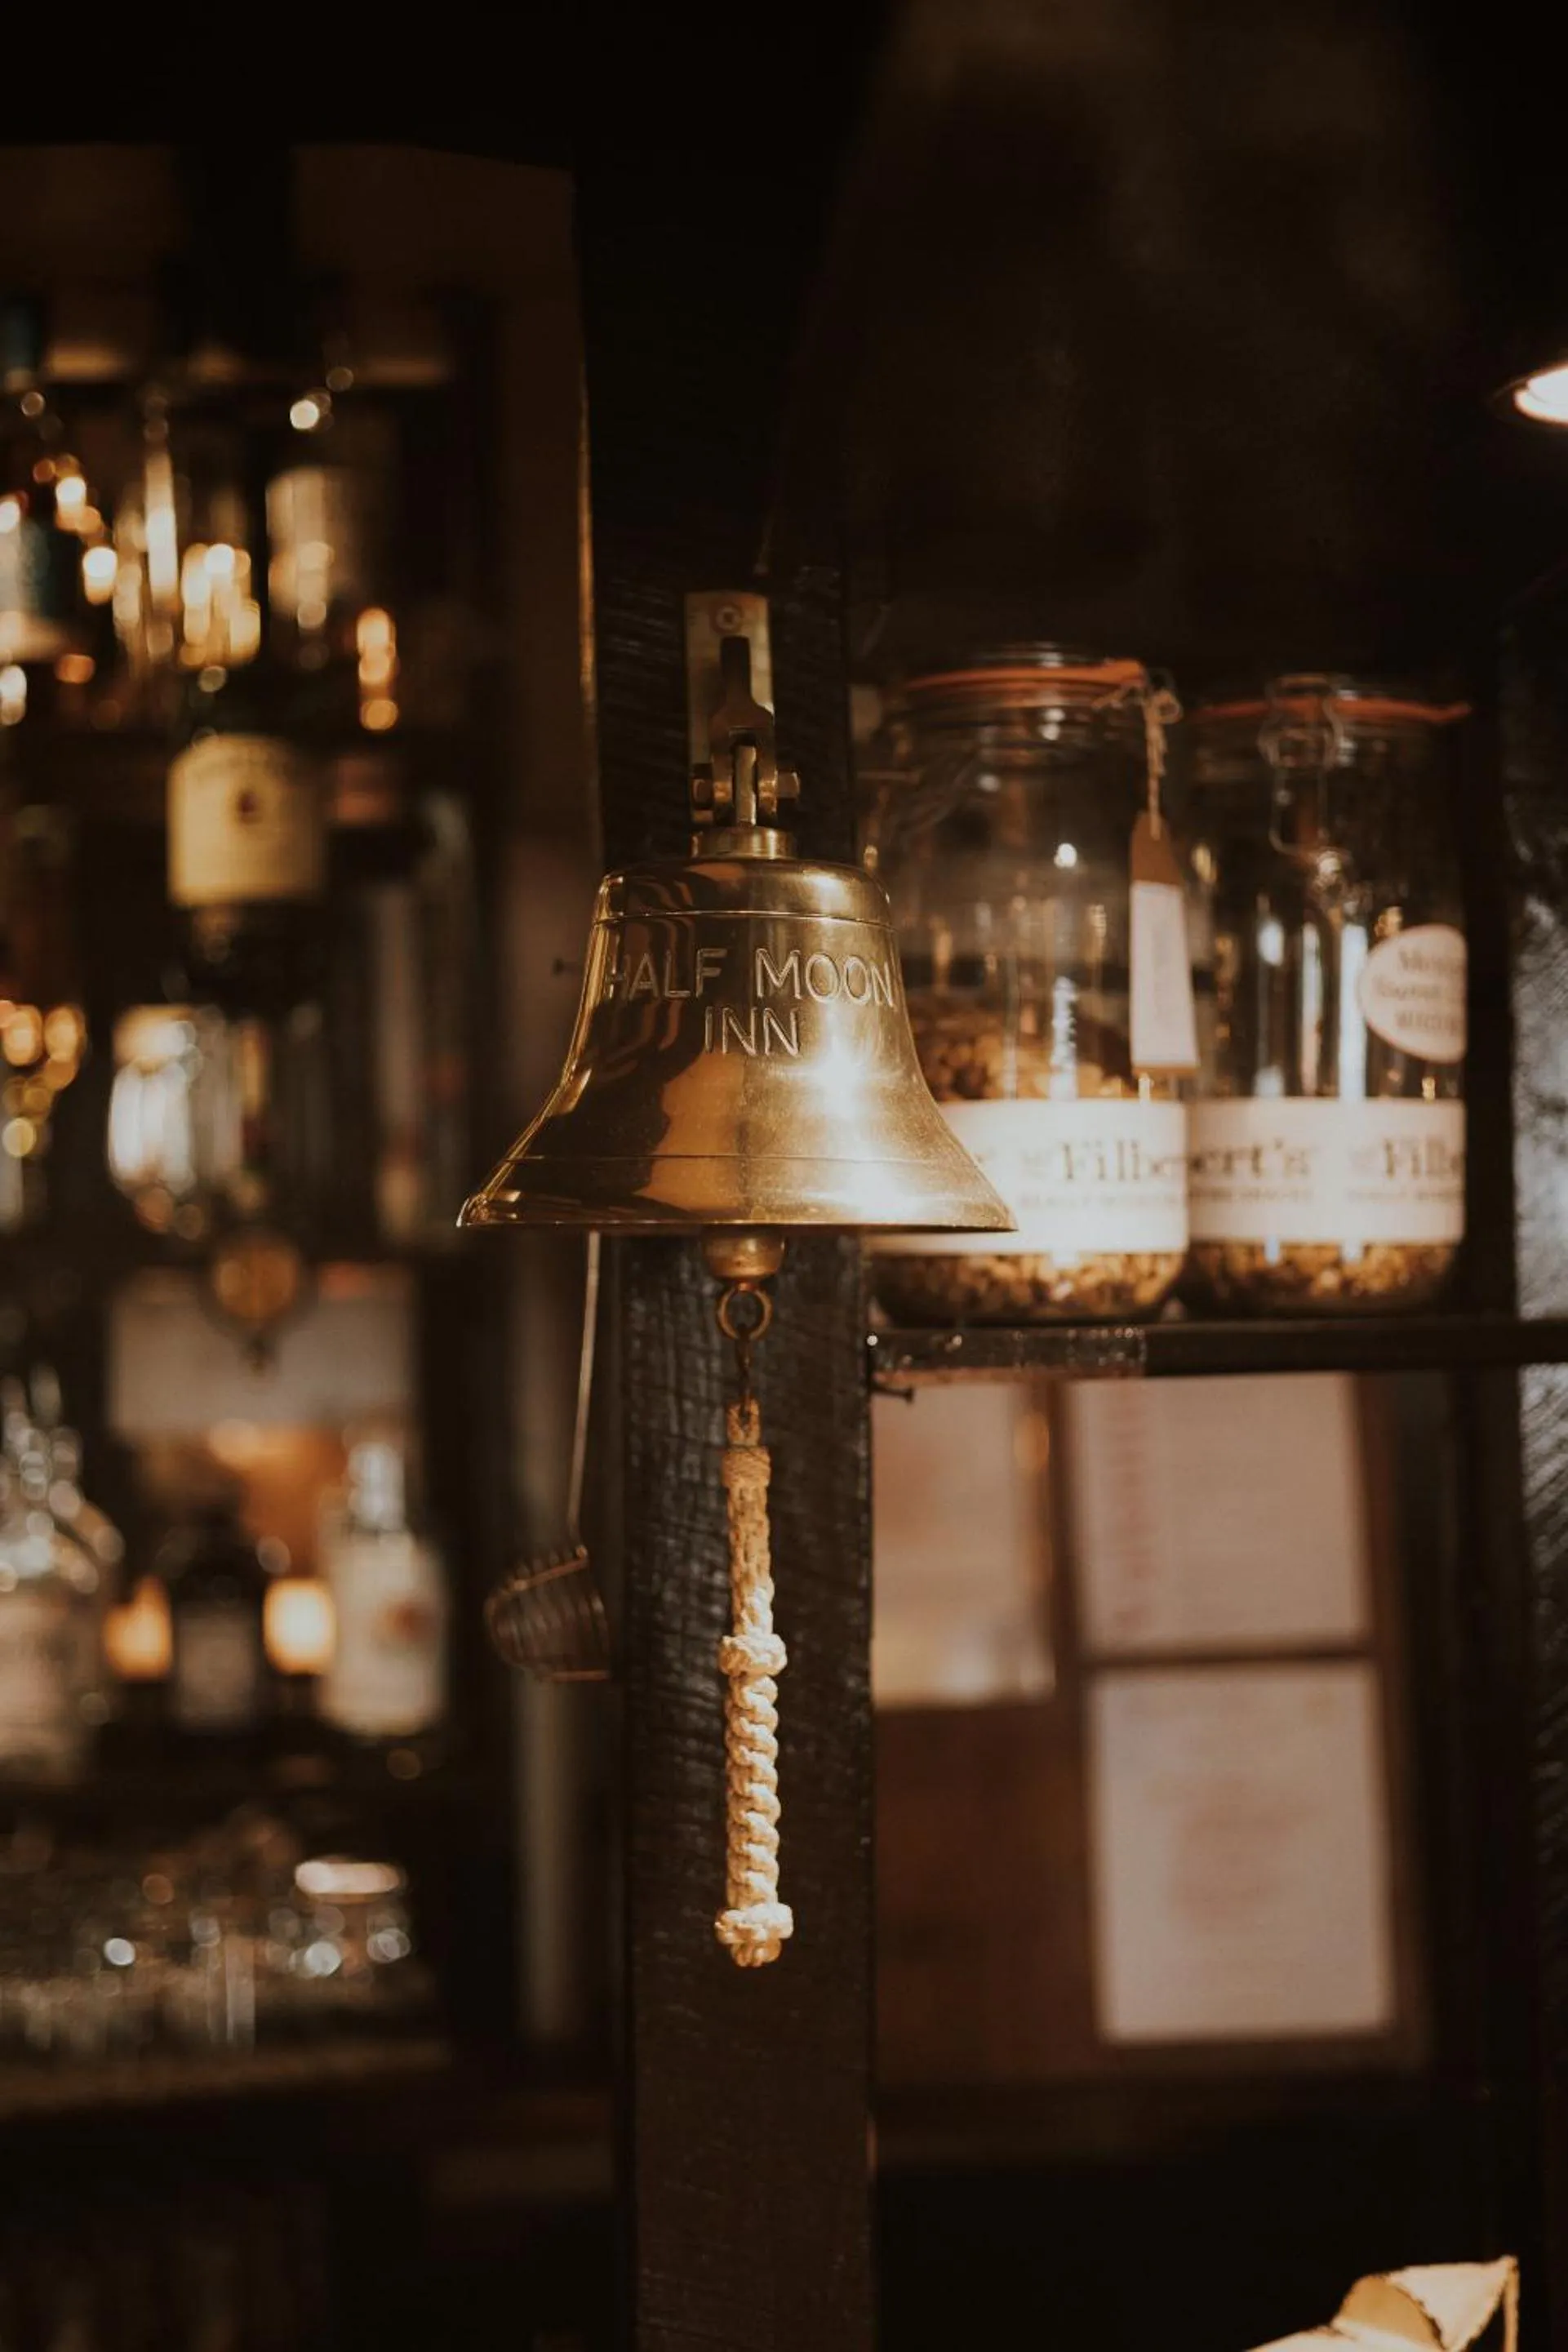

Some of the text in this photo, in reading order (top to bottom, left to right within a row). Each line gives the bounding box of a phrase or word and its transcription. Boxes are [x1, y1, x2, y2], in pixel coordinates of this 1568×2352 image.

[605, 947, 894, 1007] HALF MOON
[704, 1005, 800, 1057] INN
